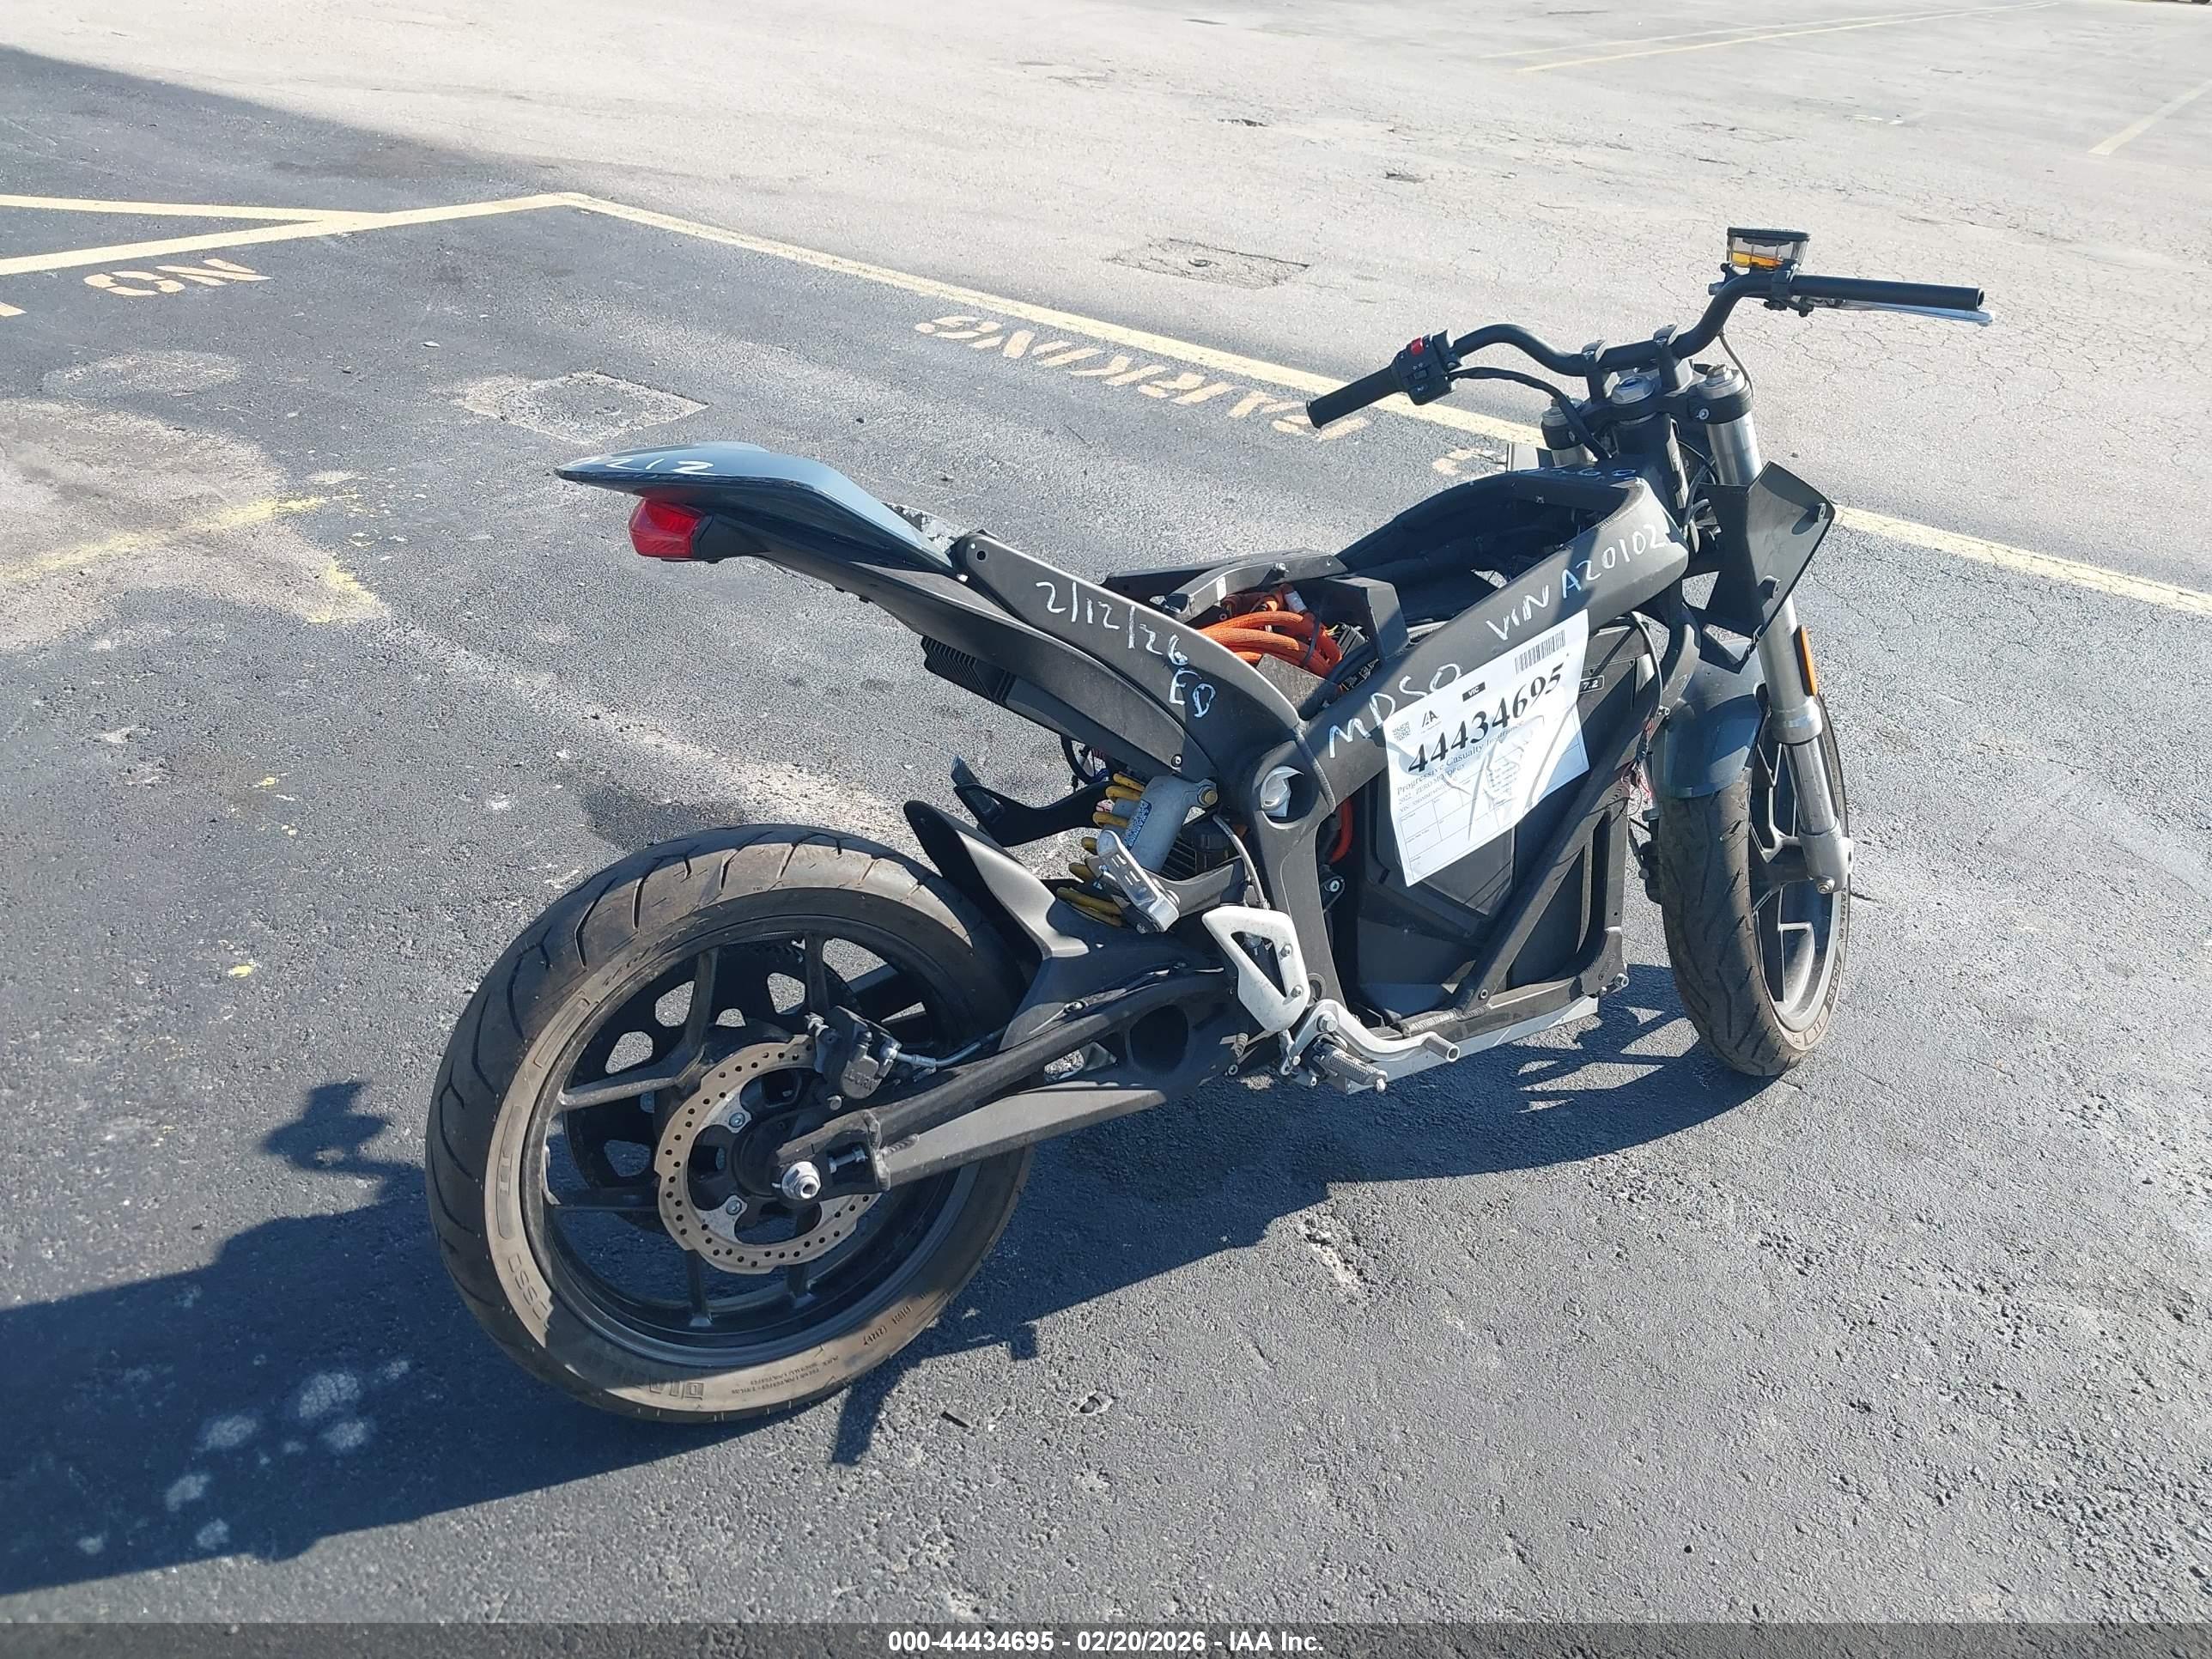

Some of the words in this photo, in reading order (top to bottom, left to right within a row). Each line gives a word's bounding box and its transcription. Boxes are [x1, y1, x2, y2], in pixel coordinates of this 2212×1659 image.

[83, 258, 274, 296] NO
[1036, 581, 1188, 666] 2/12/26
[1486, 585, 1549, 641] VIN
[1583, 679, 1599, 690] 7.2
[1408, 662, 1564, 774] 44434695
[1396, 763, 1444, 796] Progressive
[1446, 744, 1485, 767] Casualty
[1826, 959, 1841, 1005] ROSSO
